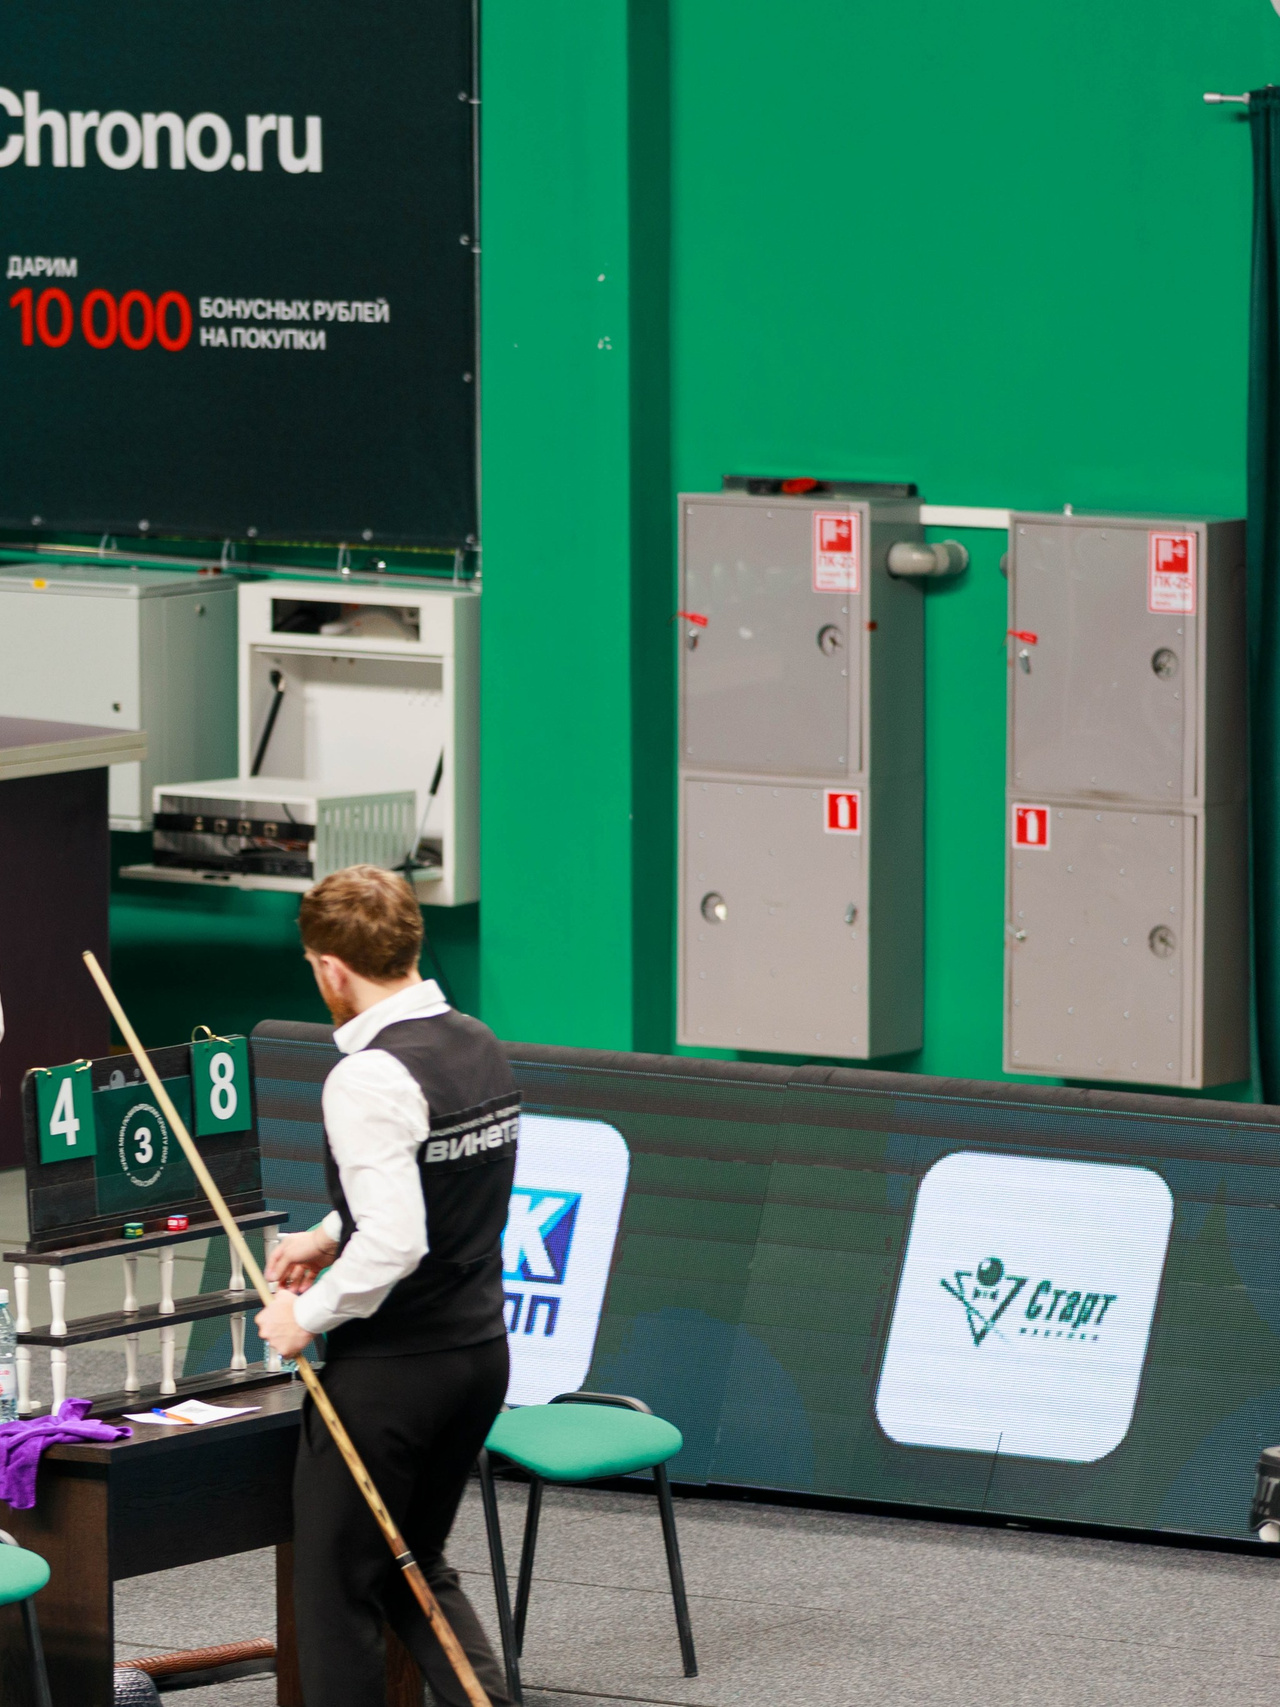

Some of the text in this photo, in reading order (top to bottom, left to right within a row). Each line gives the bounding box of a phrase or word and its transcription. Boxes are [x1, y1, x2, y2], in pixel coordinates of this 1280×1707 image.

[6, 255, 78, 279] ДАРИМ
[199, 296, 390, 324] БОНУСНЫХ РУБЛЕЙ
[200, 327, 326, 351] НА ПОКУПКИ
[209, 1052, 238, 1120] 8
[49, 1077, 80, 1146] 4
[134, 1126, 154, 1164] 3
[1025, 1280, 1118, 1330] Старт
